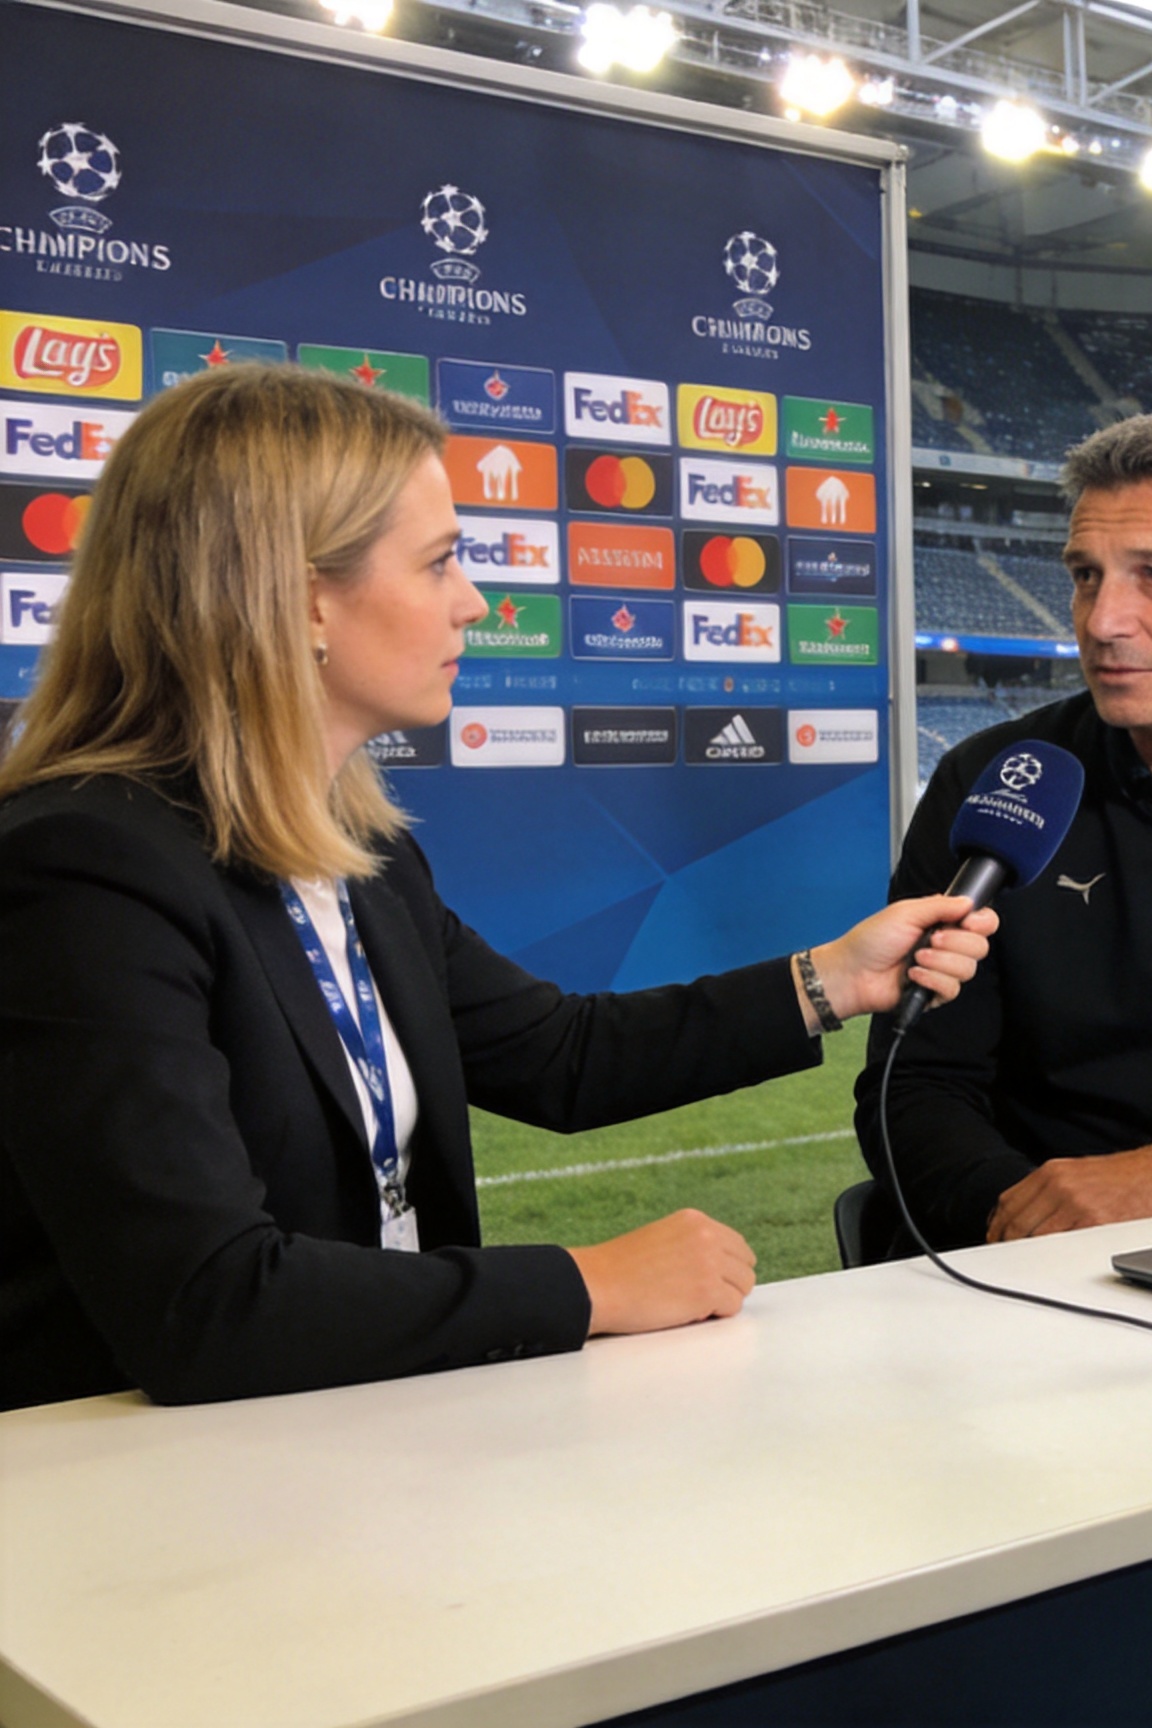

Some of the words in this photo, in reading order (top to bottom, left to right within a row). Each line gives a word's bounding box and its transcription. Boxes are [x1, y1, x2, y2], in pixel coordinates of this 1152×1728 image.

[574, 387, 663, 428] FedEx
[688, 472, 771, 510] FedEx
[693, 613, 773, 647] FedEx
